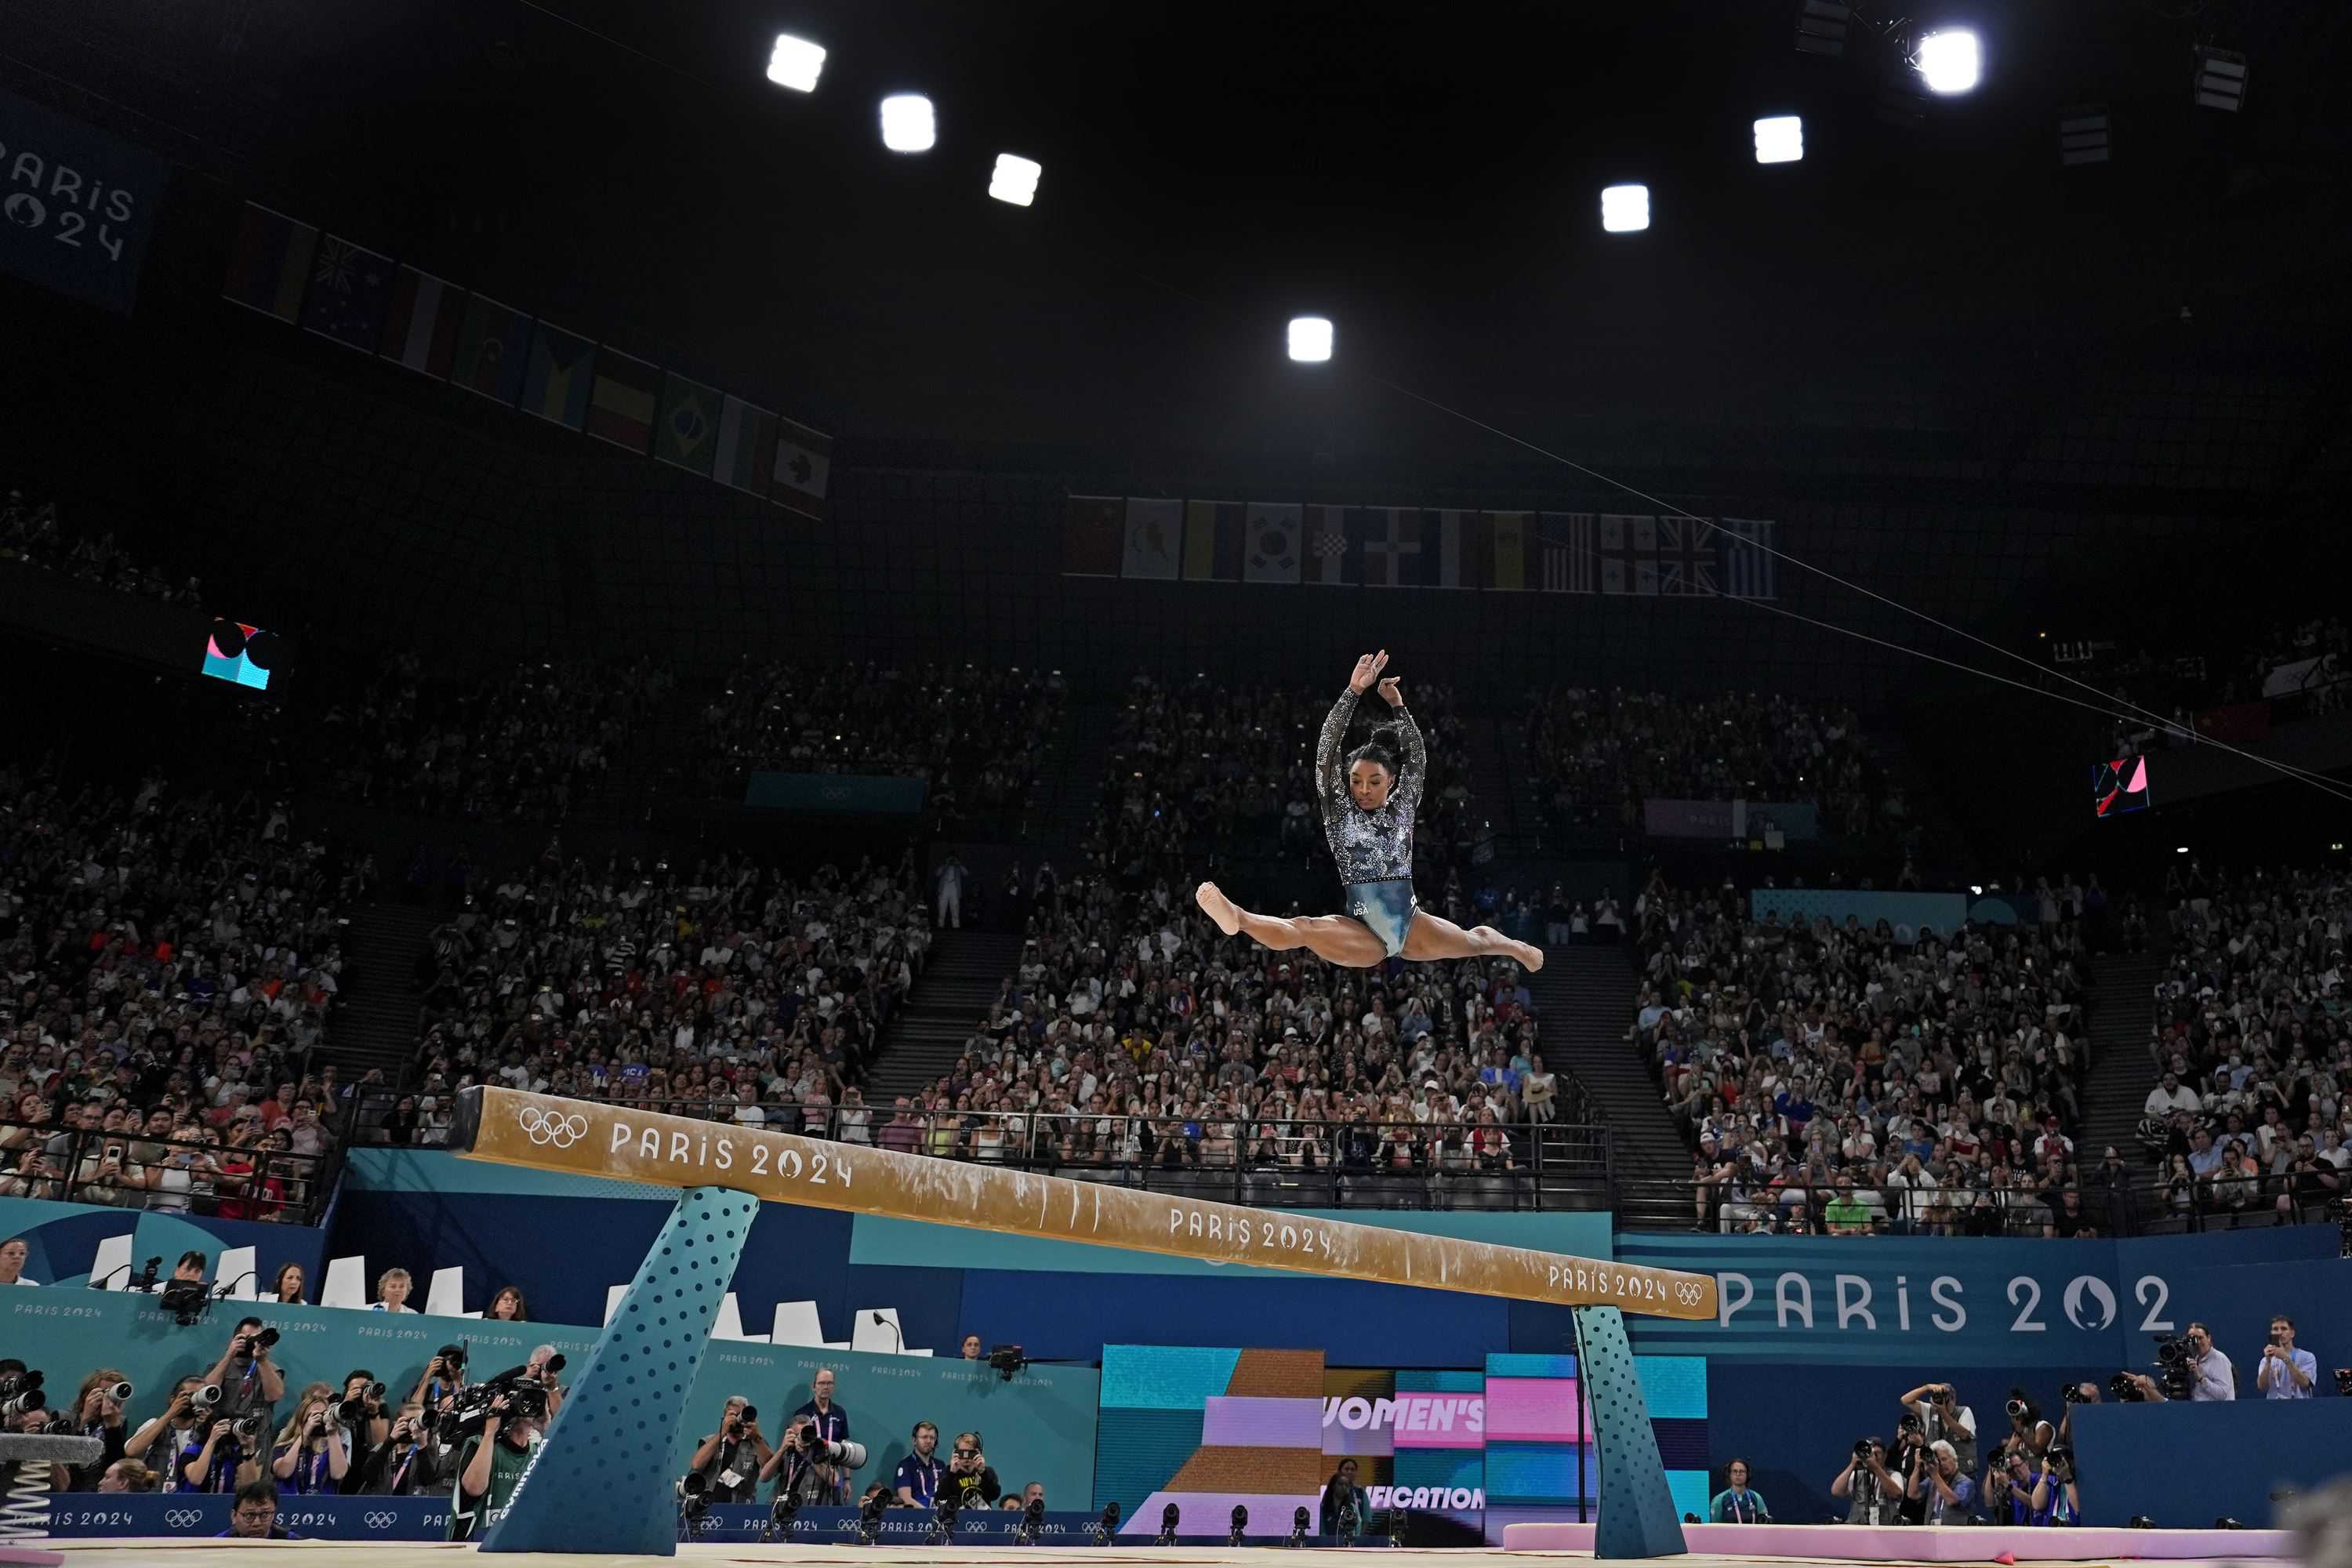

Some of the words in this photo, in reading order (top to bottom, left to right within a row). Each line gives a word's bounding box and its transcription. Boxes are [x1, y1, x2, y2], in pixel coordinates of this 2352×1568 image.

[0, 142, 134, 222] ARiS
[1353, 906, 1369, 916] USA
[750, 1144, 852, 1188] 2024
[1262, 1222, 1331, 1255] 2024
[1615, 1275, 1666, 1301] 2024
[2006, 1275, 2175, 1332] 202
[63, 1307, 102, 1318] 2024
[294, 1322, 327, 1333] 2024
[396, 1329, 427, 1340] 2024
[492, 1336, 521, 1346] 2024
[750, 1356, 775, 1367] 2024
[80, 1512, 132, 1526] 2024
[290, 1513, 336, 1526] 2024
